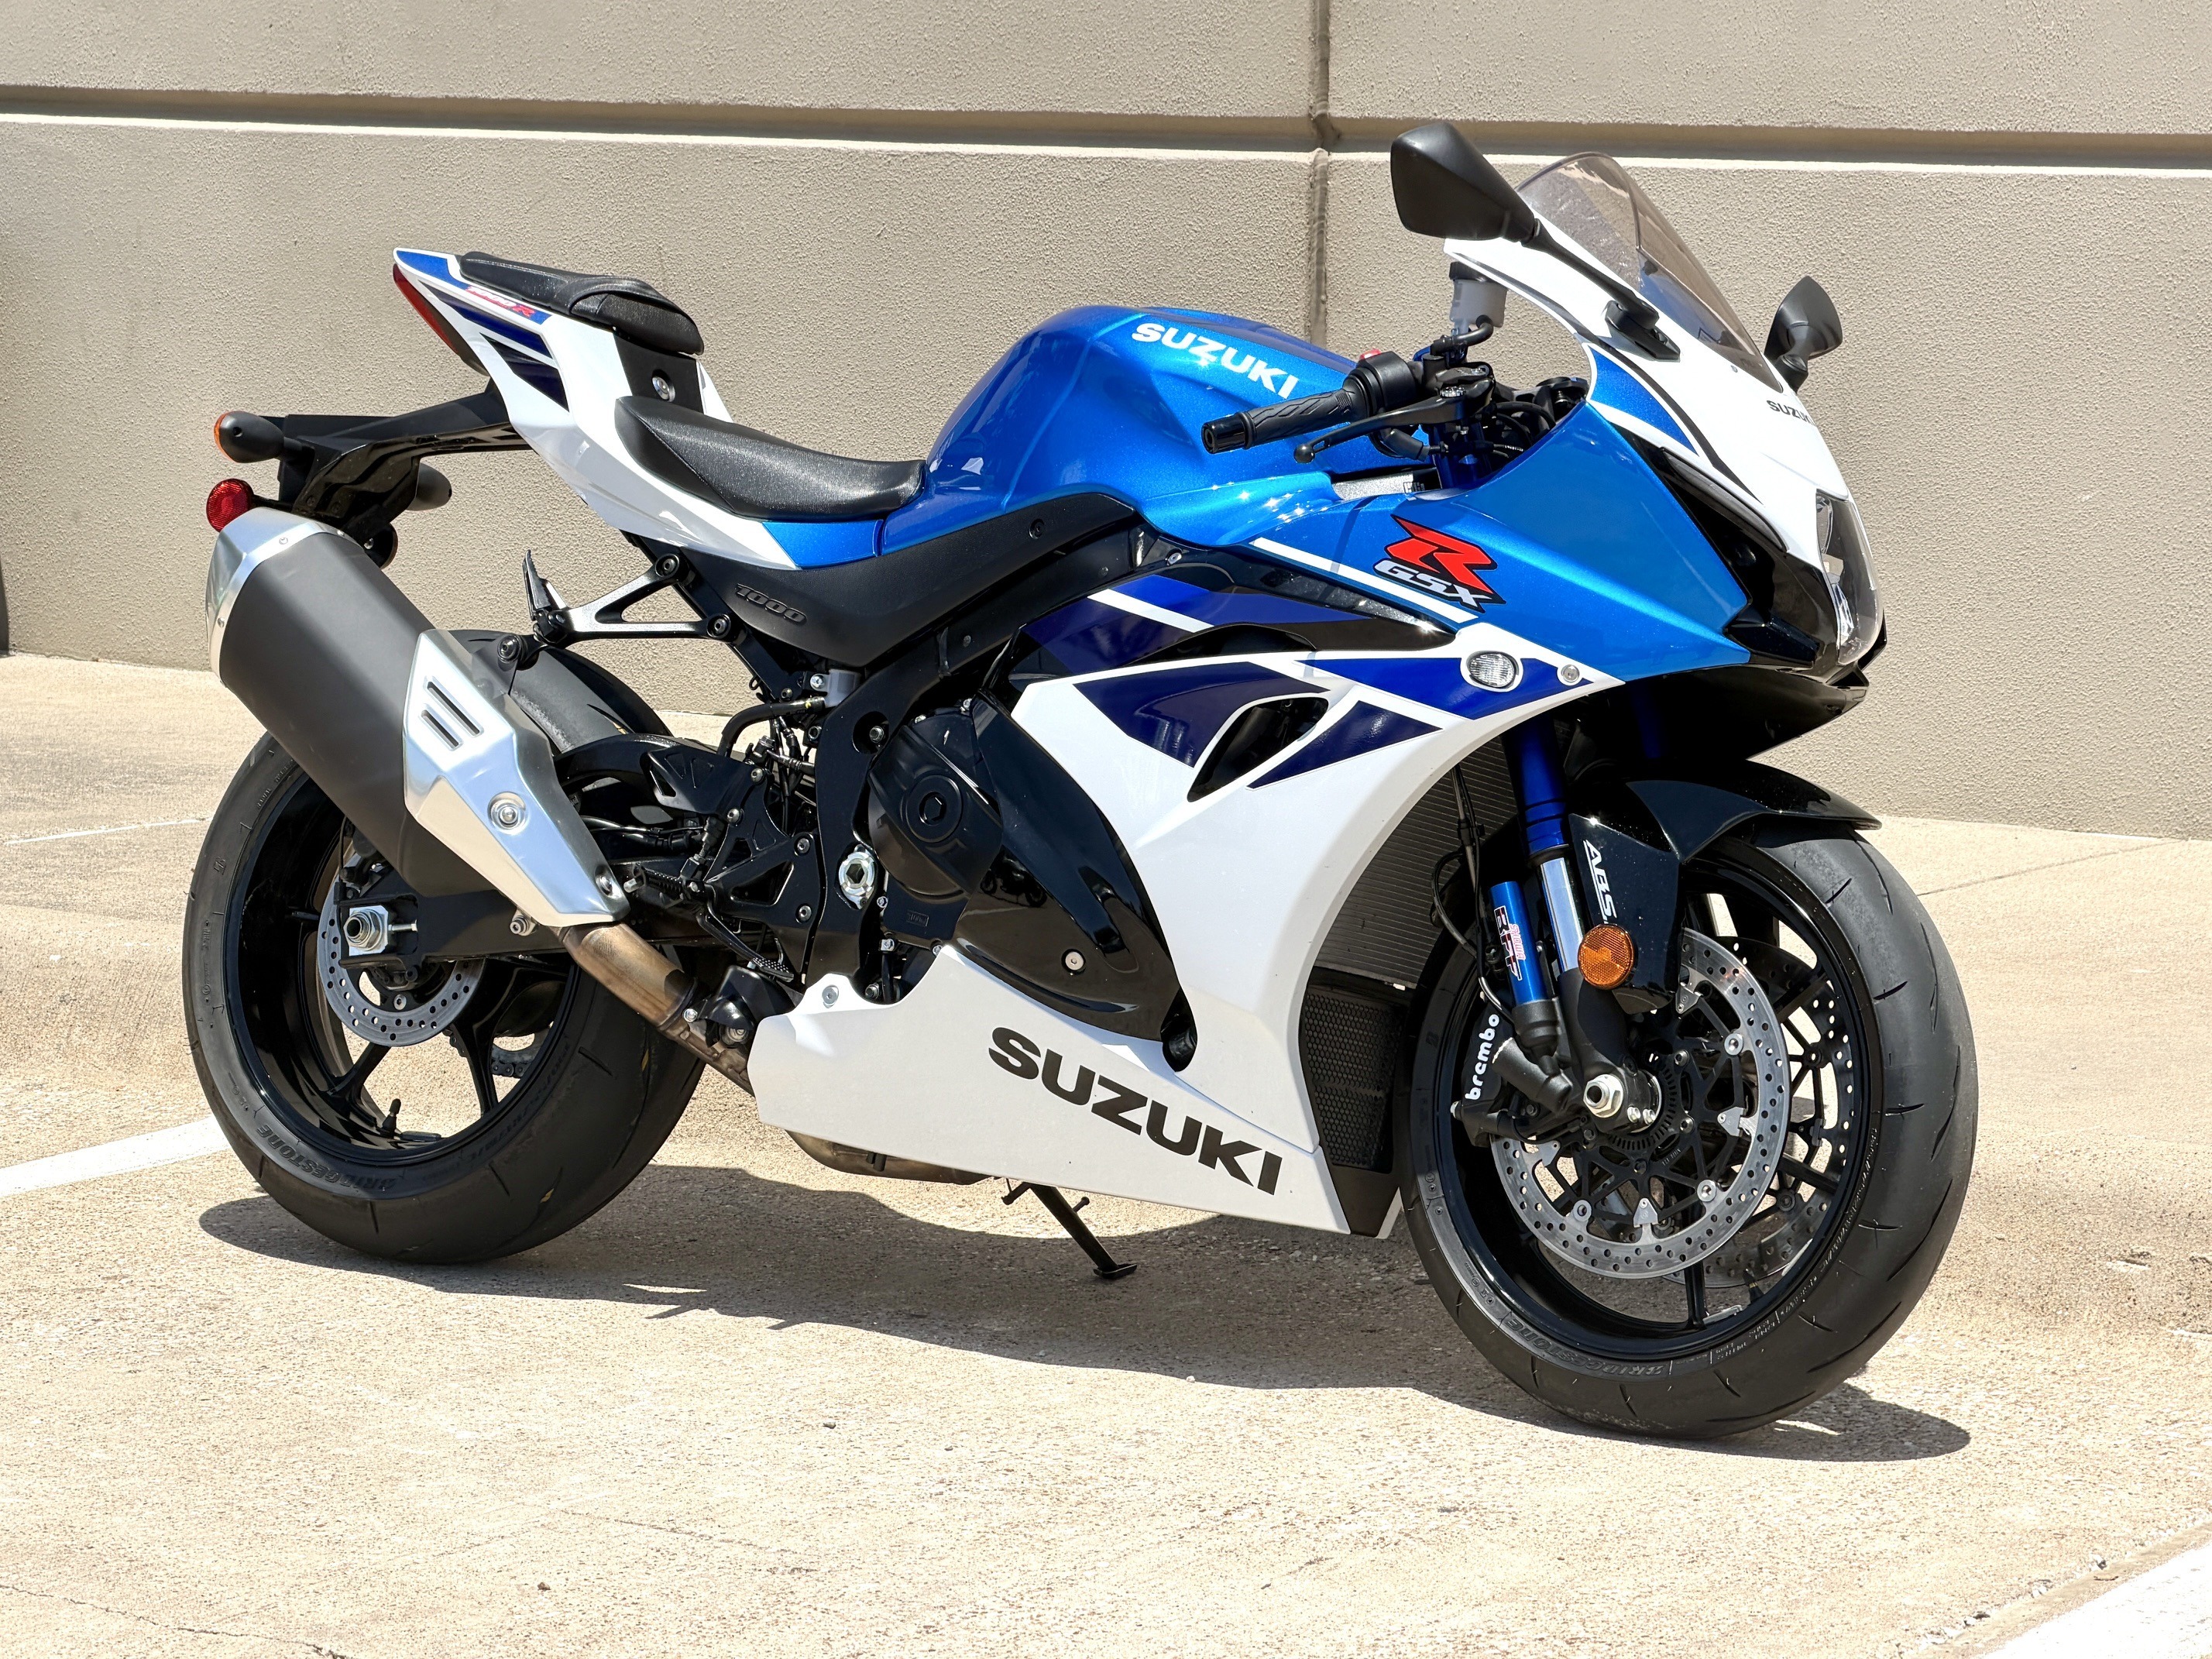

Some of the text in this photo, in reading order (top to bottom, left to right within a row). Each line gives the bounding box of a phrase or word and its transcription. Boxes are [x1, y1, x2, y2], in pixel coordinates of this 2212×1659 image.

[1132, 323, 1300, 399] SUZUKI
[1374, 559, 1492, 608] GSX
[1392, 515, 1496, 598] R
[735, 583, 807, 623] 1000
[1583, 840, 1617, 922] ABS
[1494, 905, 1522, 981] BFF
[1465, 1014, 1499, 1100] brembo
[988, 1027, 1283, 1195] SUZUKI
[256, 1124, 397, 1190] BRIDGESTONE
[1506, 1319, 1665, 1376] BRIDGESTONE
